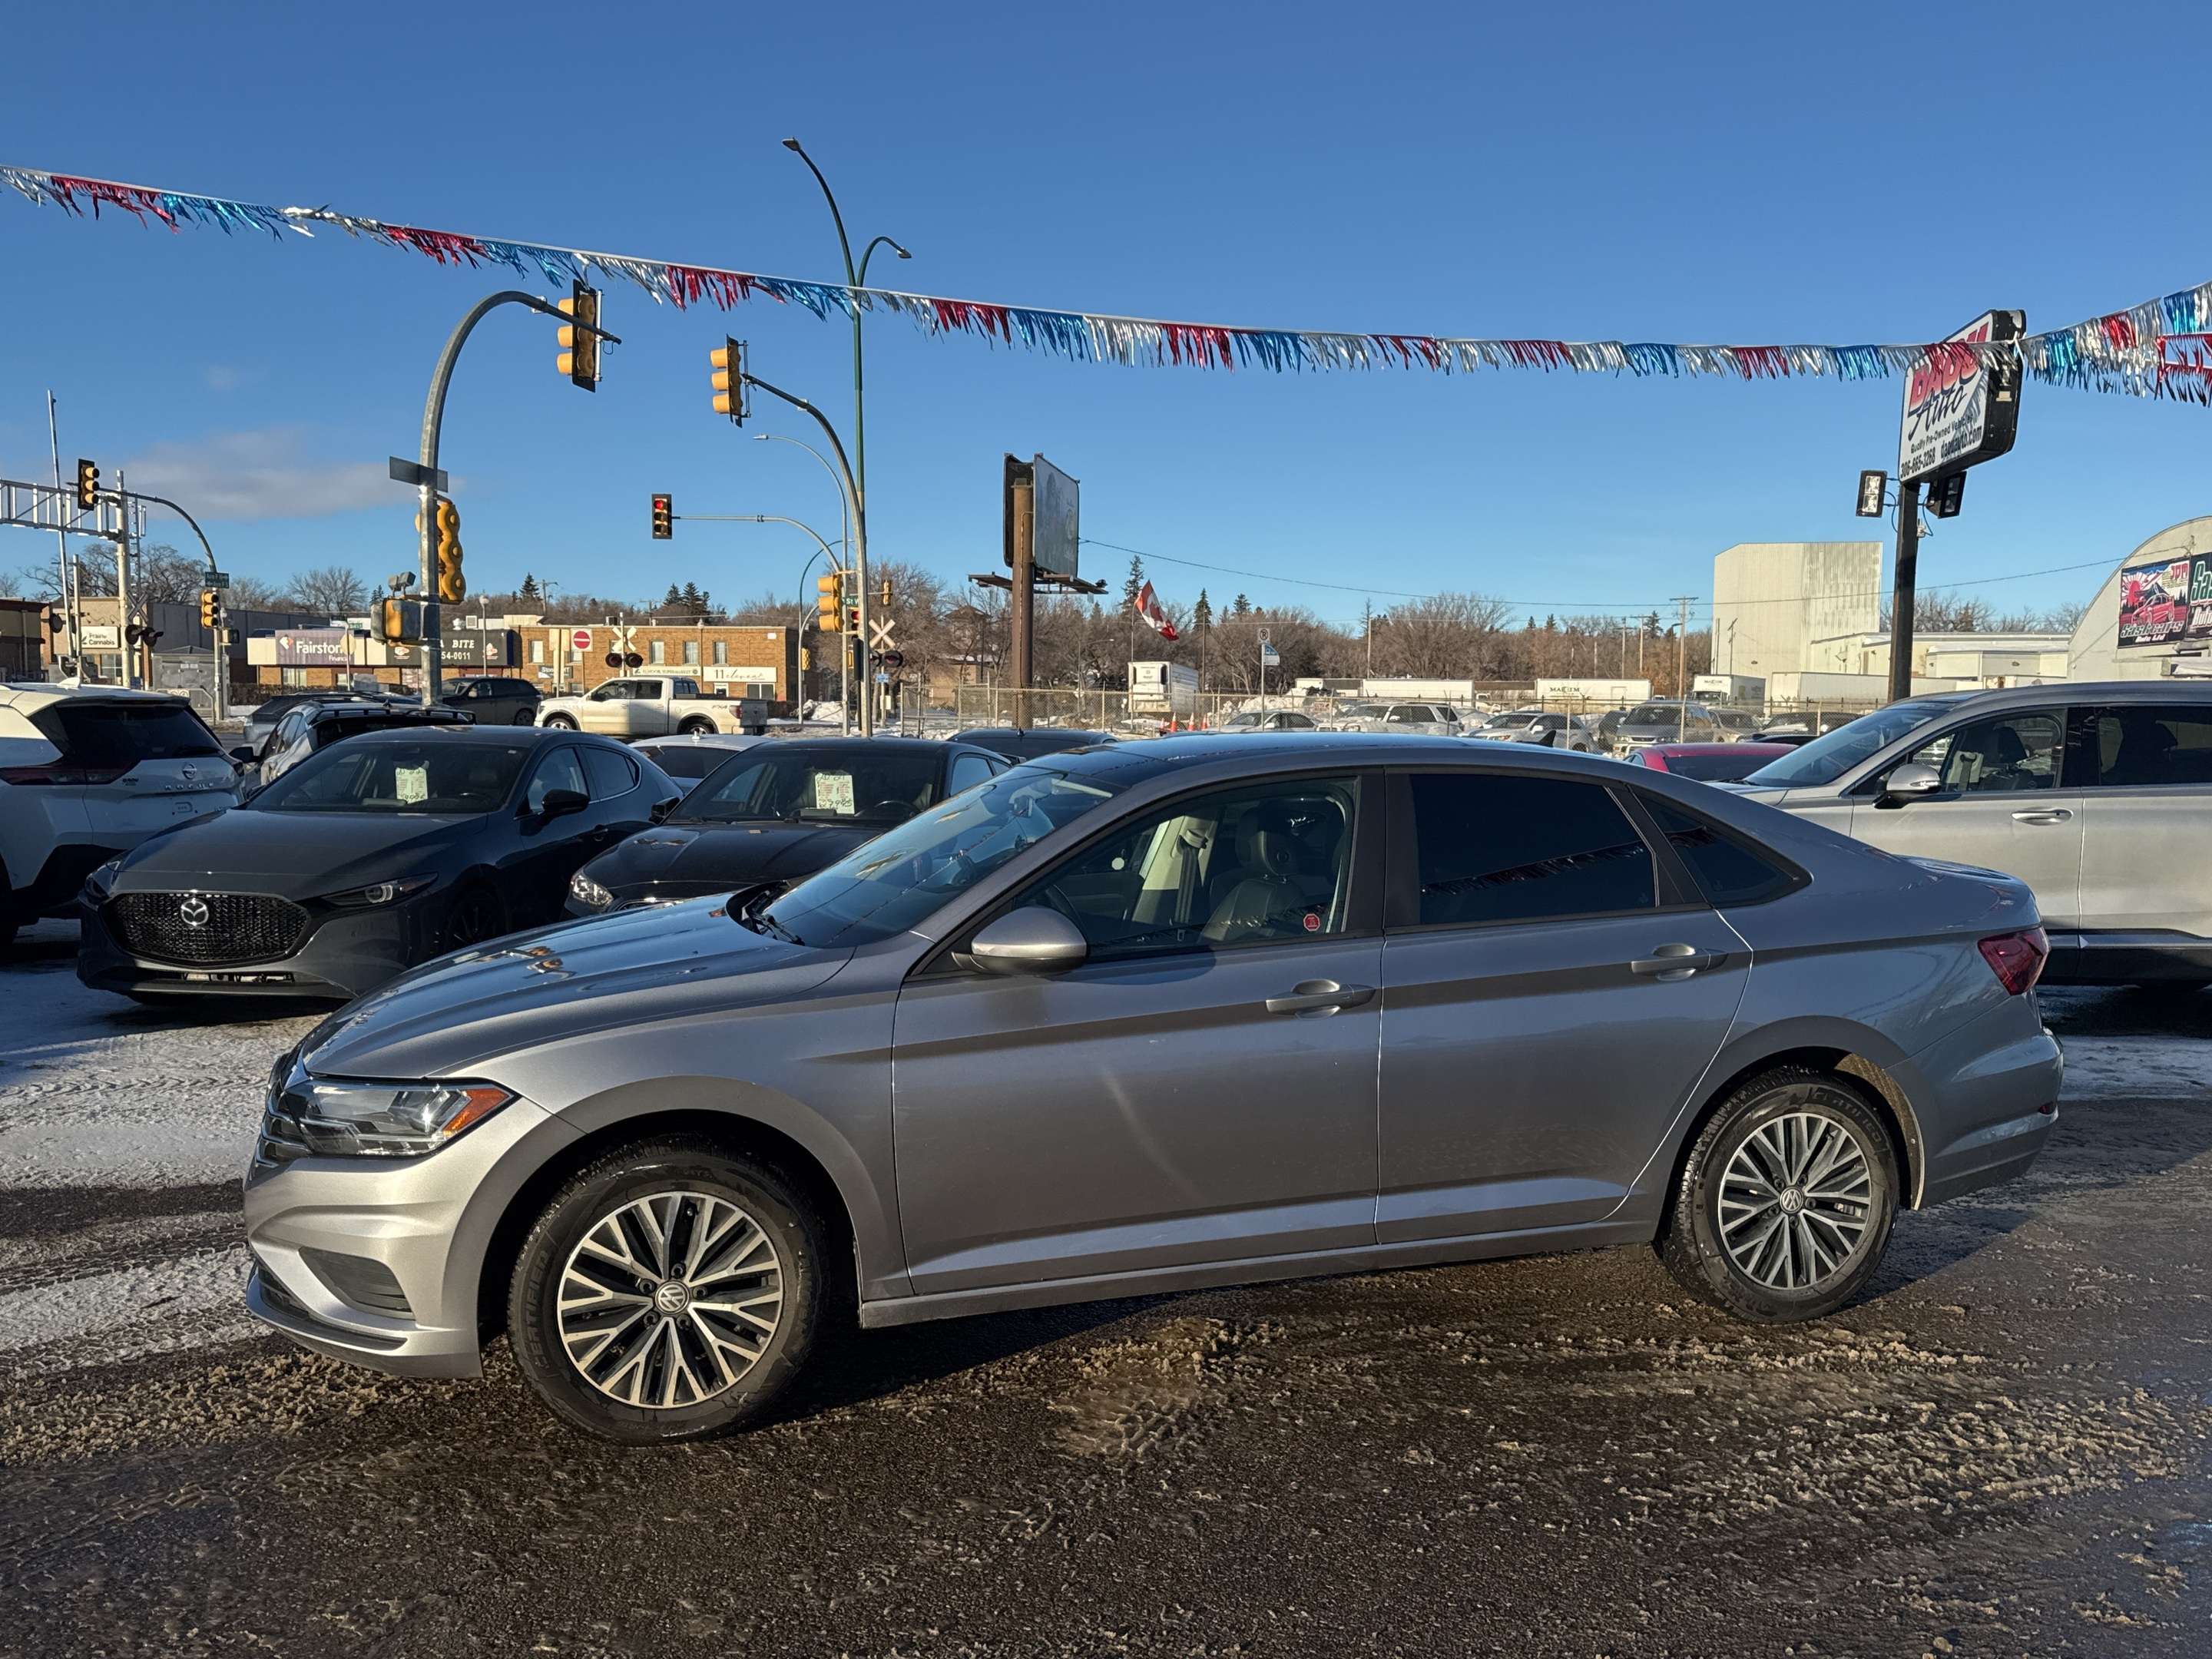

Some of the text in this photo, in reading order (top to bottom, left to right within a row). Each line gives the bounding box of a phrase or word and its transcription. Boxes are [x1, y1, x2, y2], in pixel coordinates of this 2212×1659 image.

[1909, 385, 1968, 442] Auto
[1911, 439, 1926, 454] Quality
[1926, 422, 1951, 445] Pre-Owned
[296, 640, 343, 654] Fairston
[452, 639, 475, 648] BITE
[714, 669, 724, 679] 11
